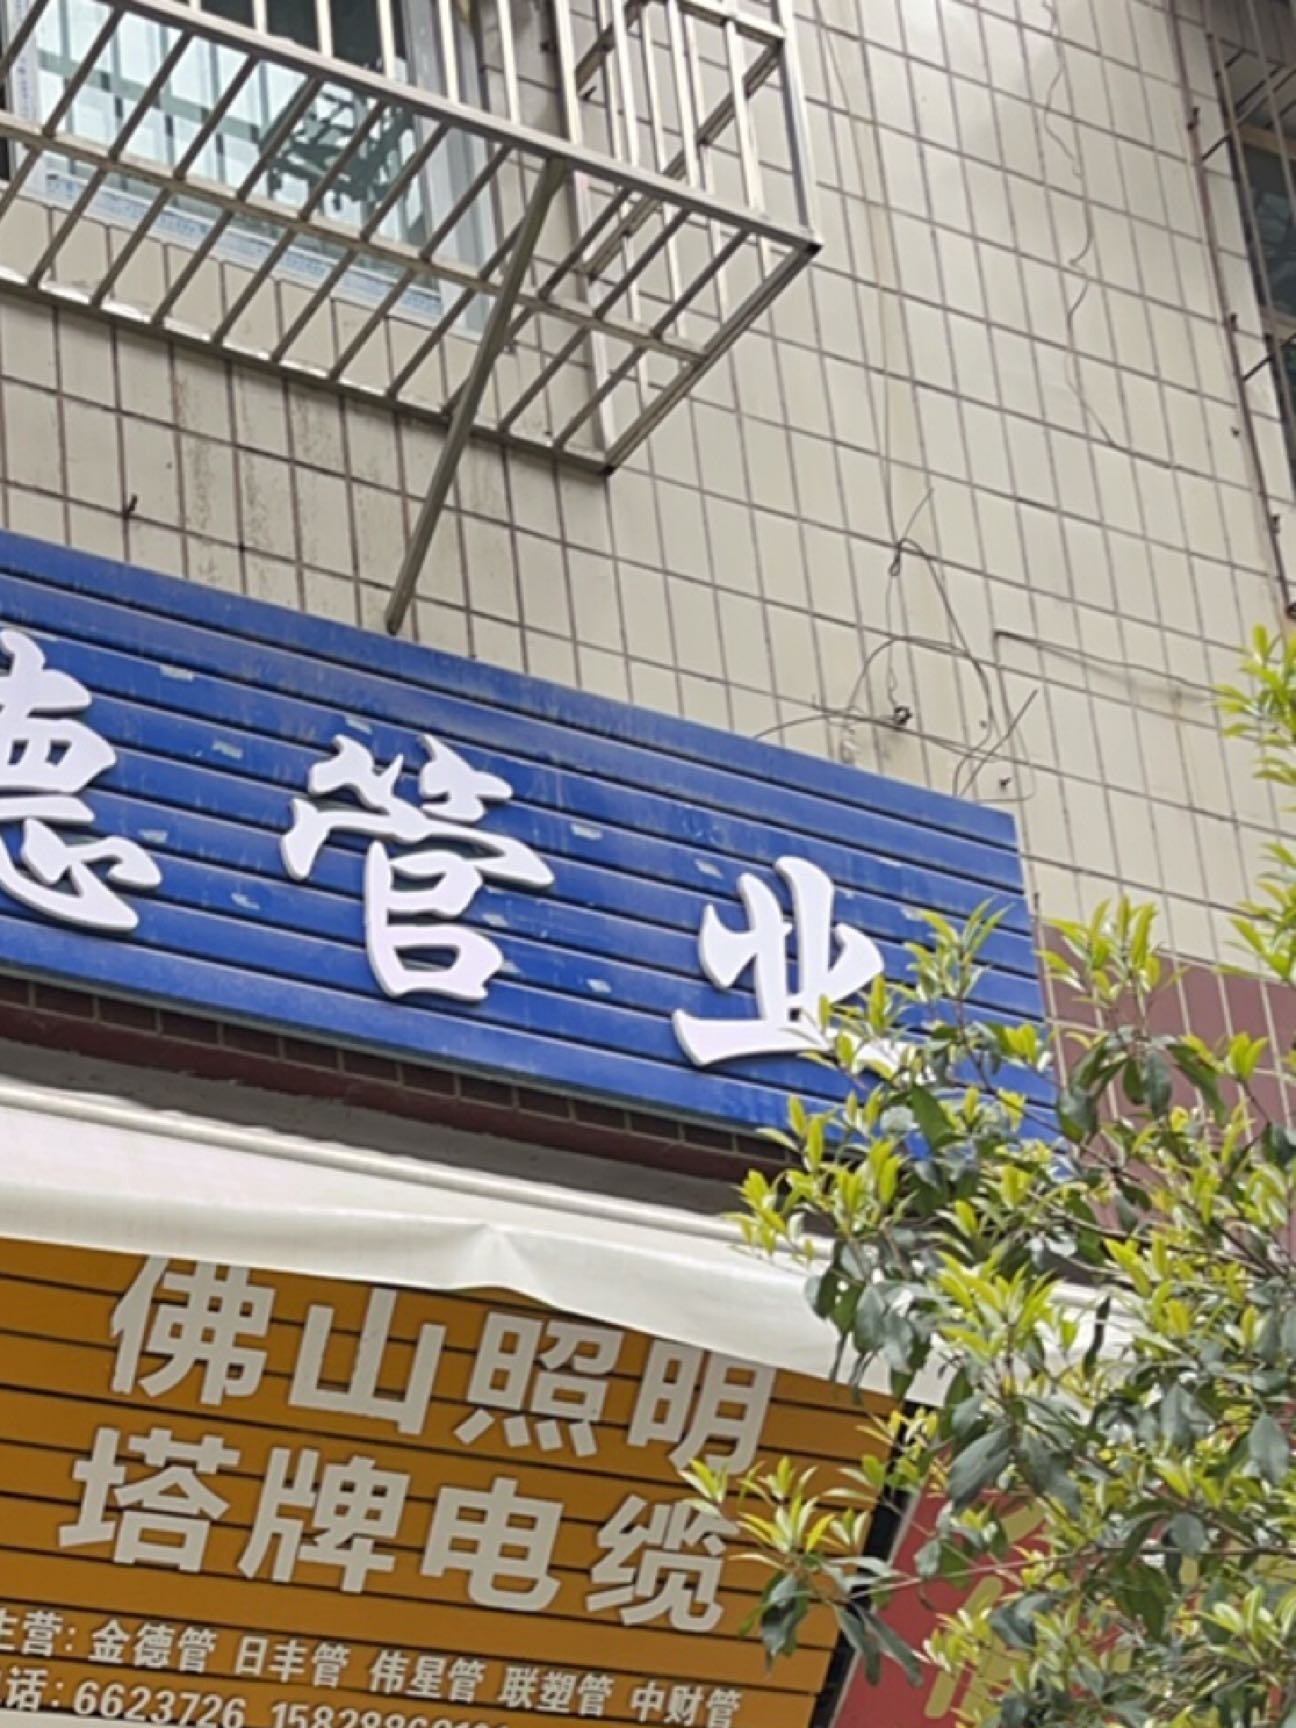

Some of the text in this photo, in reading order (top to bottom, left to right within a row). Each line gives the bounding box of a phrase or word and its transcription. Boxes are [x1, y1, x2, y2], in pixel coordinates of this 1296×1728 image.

[109, 1255, 777, 1472] 佛山照明
[56, 1427, 740, 1634] 塔牌电缆
